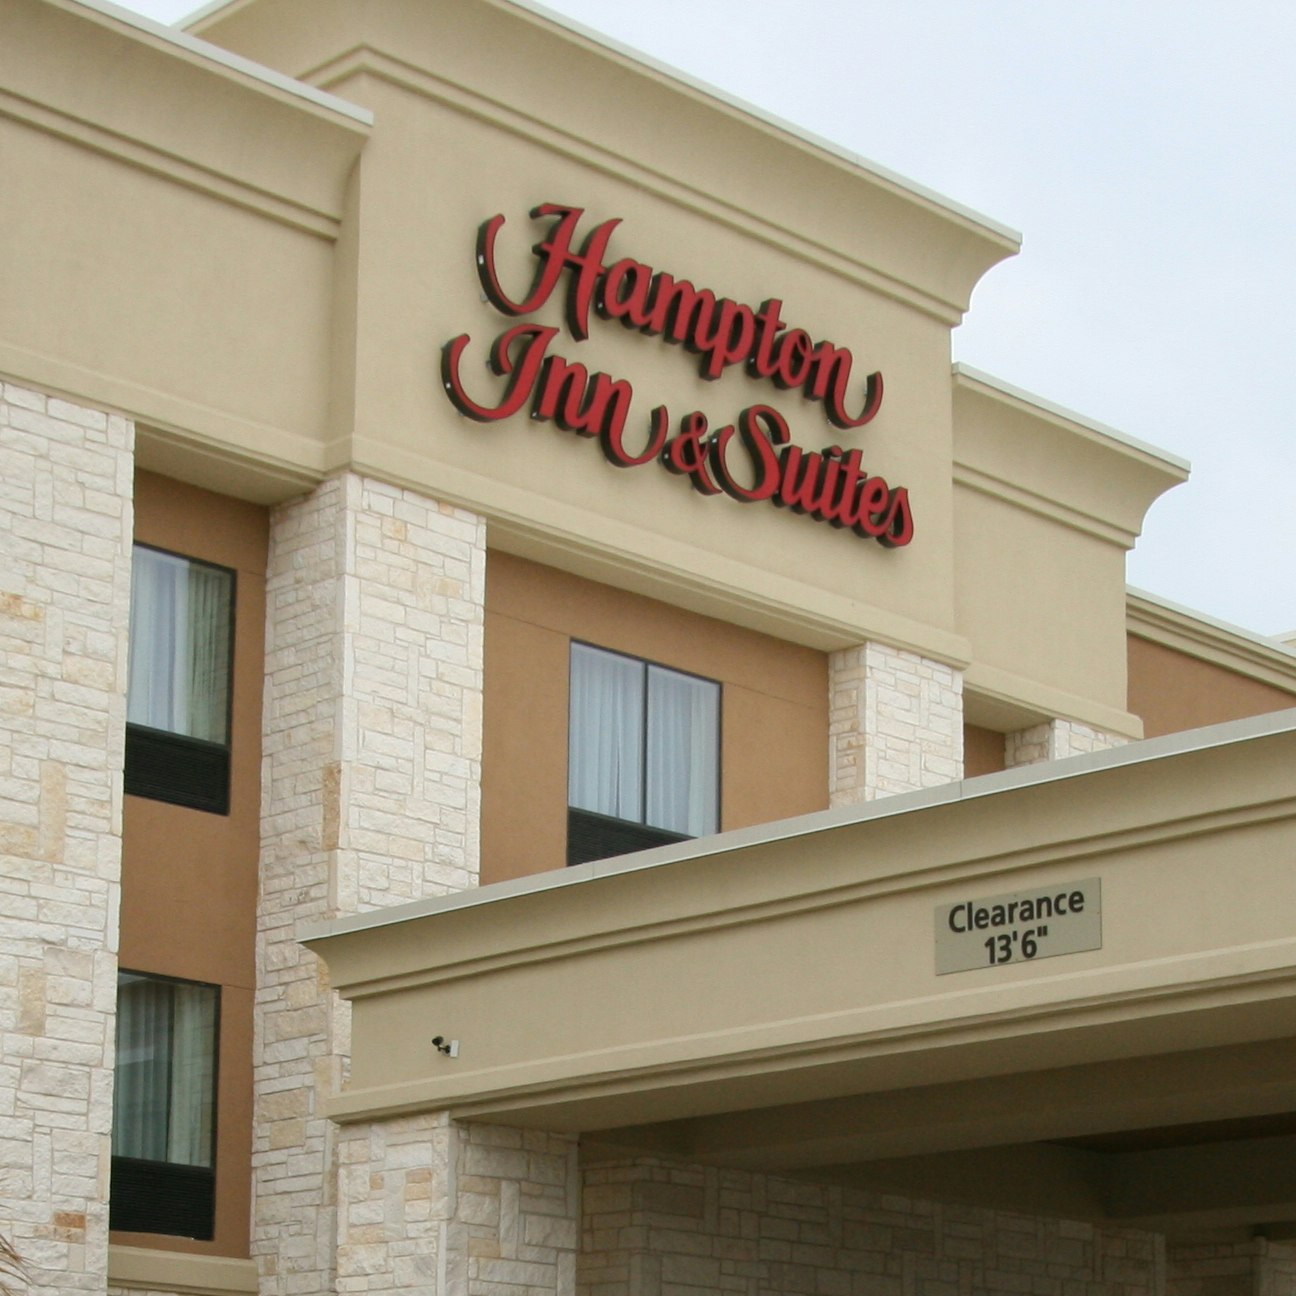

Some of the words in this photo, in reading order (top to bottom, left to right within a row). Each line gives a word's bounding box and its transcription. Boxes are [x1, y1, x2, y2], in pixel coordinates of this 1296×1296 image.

[476, 203, 884, 430] Hampton
[441, 324, 669, 468] Inn
[663, 411, 722, 496] &
[710, 404, 914, 549] Suites
[948, 890, 1085, 933] Clearance
